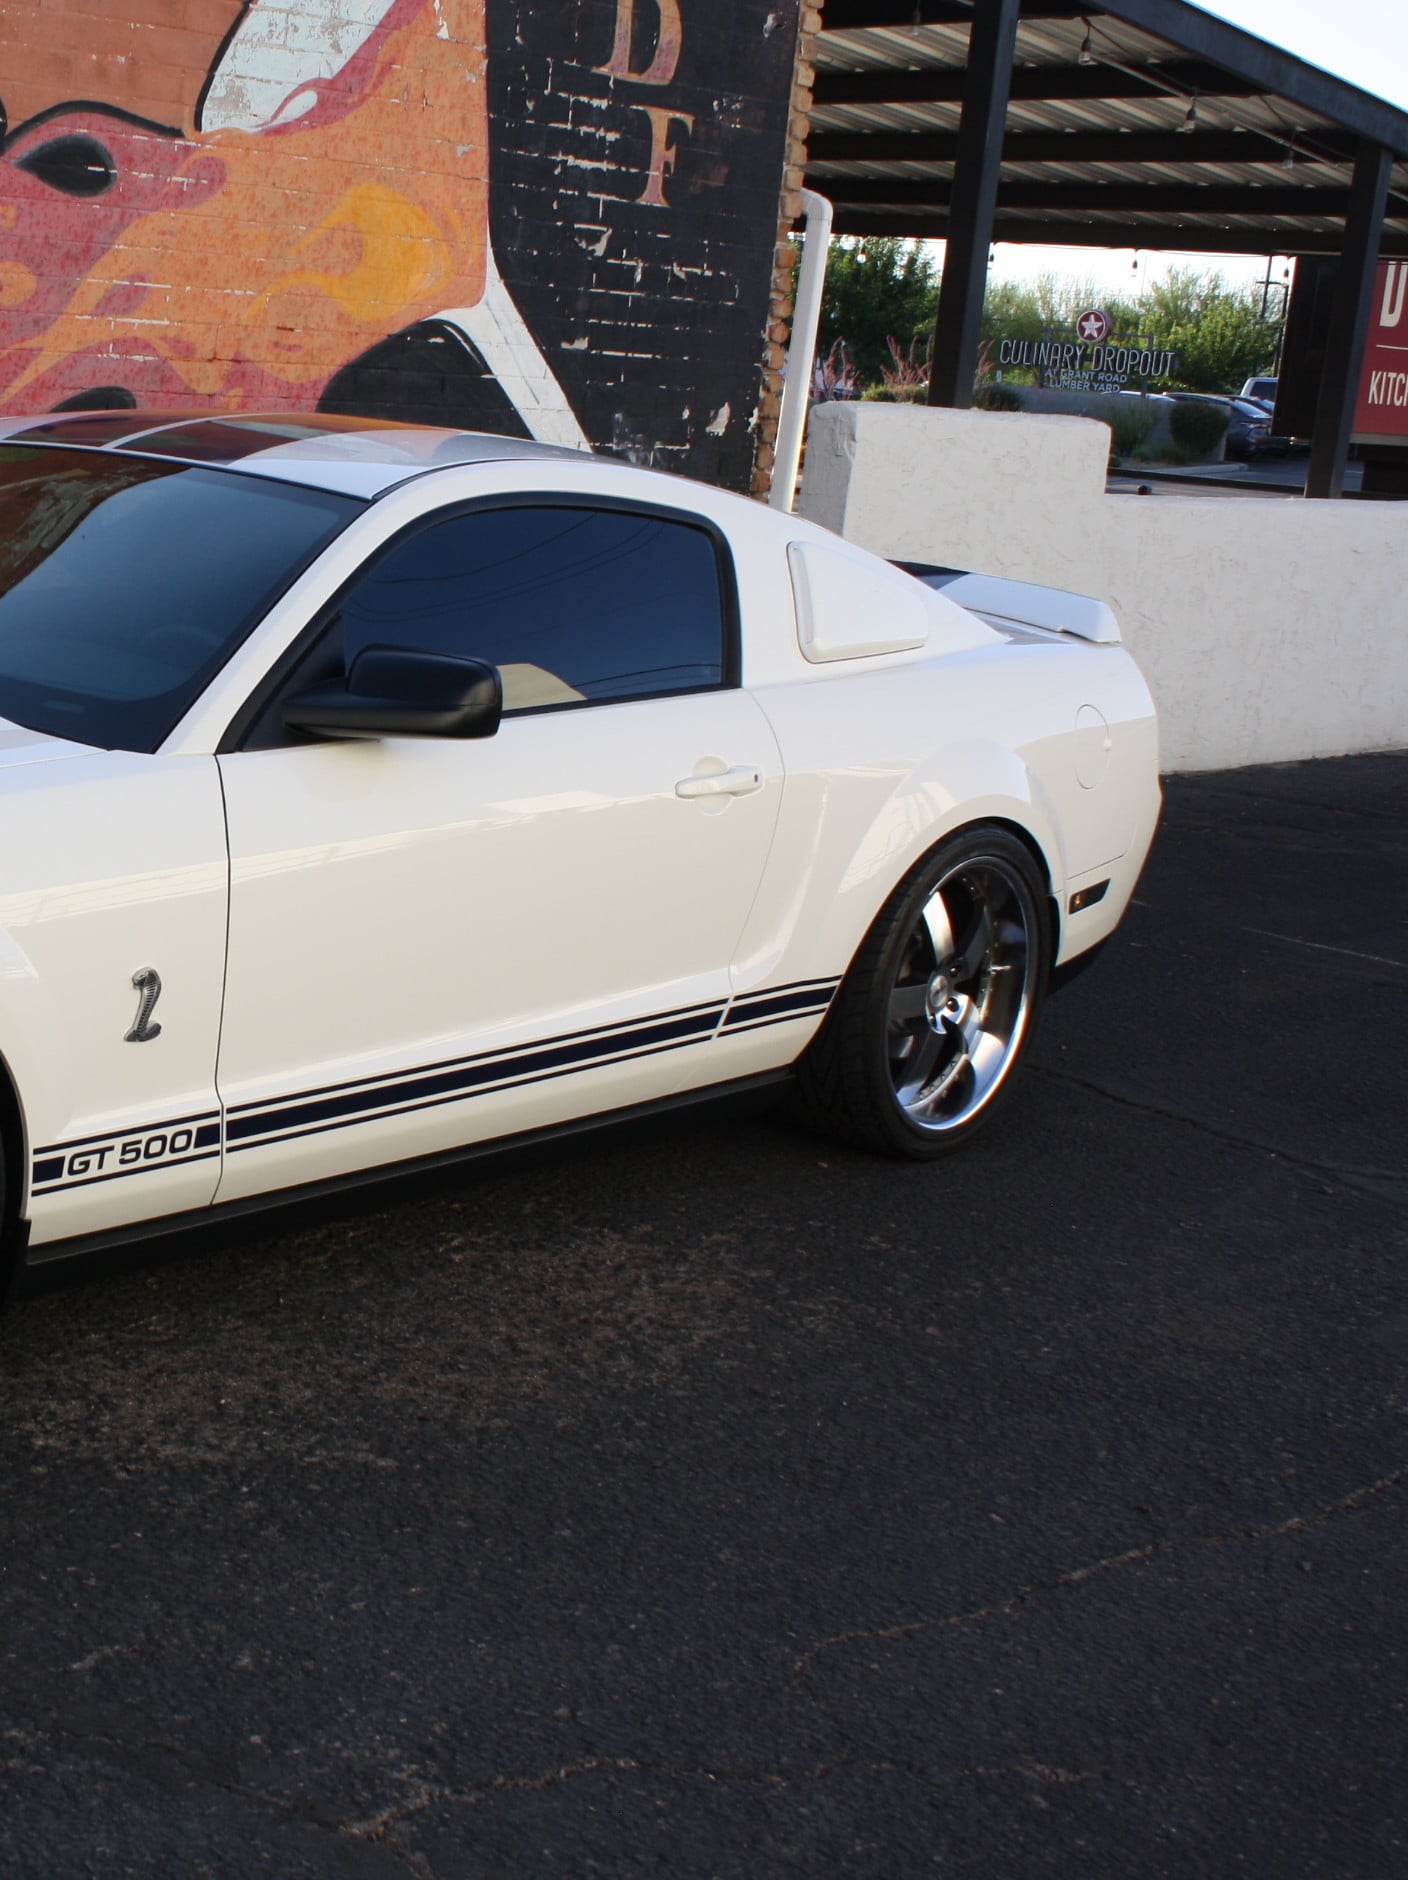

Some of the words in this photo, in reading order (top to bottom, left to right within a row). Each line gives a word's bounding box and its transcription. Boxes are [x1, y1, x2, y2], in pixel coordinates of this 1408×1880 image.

[999, 339, 1086, 370] CULINARY
[1092, 345, 1176, 377] DROPOUT
[1045, 368, 1058, 378] AT
[1060, 370, 1094, 382] GRANT
[1098, 372, 1128, 383] ROAD
[1049, 379, 1090, 391] LUMBER
[1092, 382, 1121, 393] YARD
[67, 1144, 115, 1176] GT
[118, 1128, 193, 1165] 500
